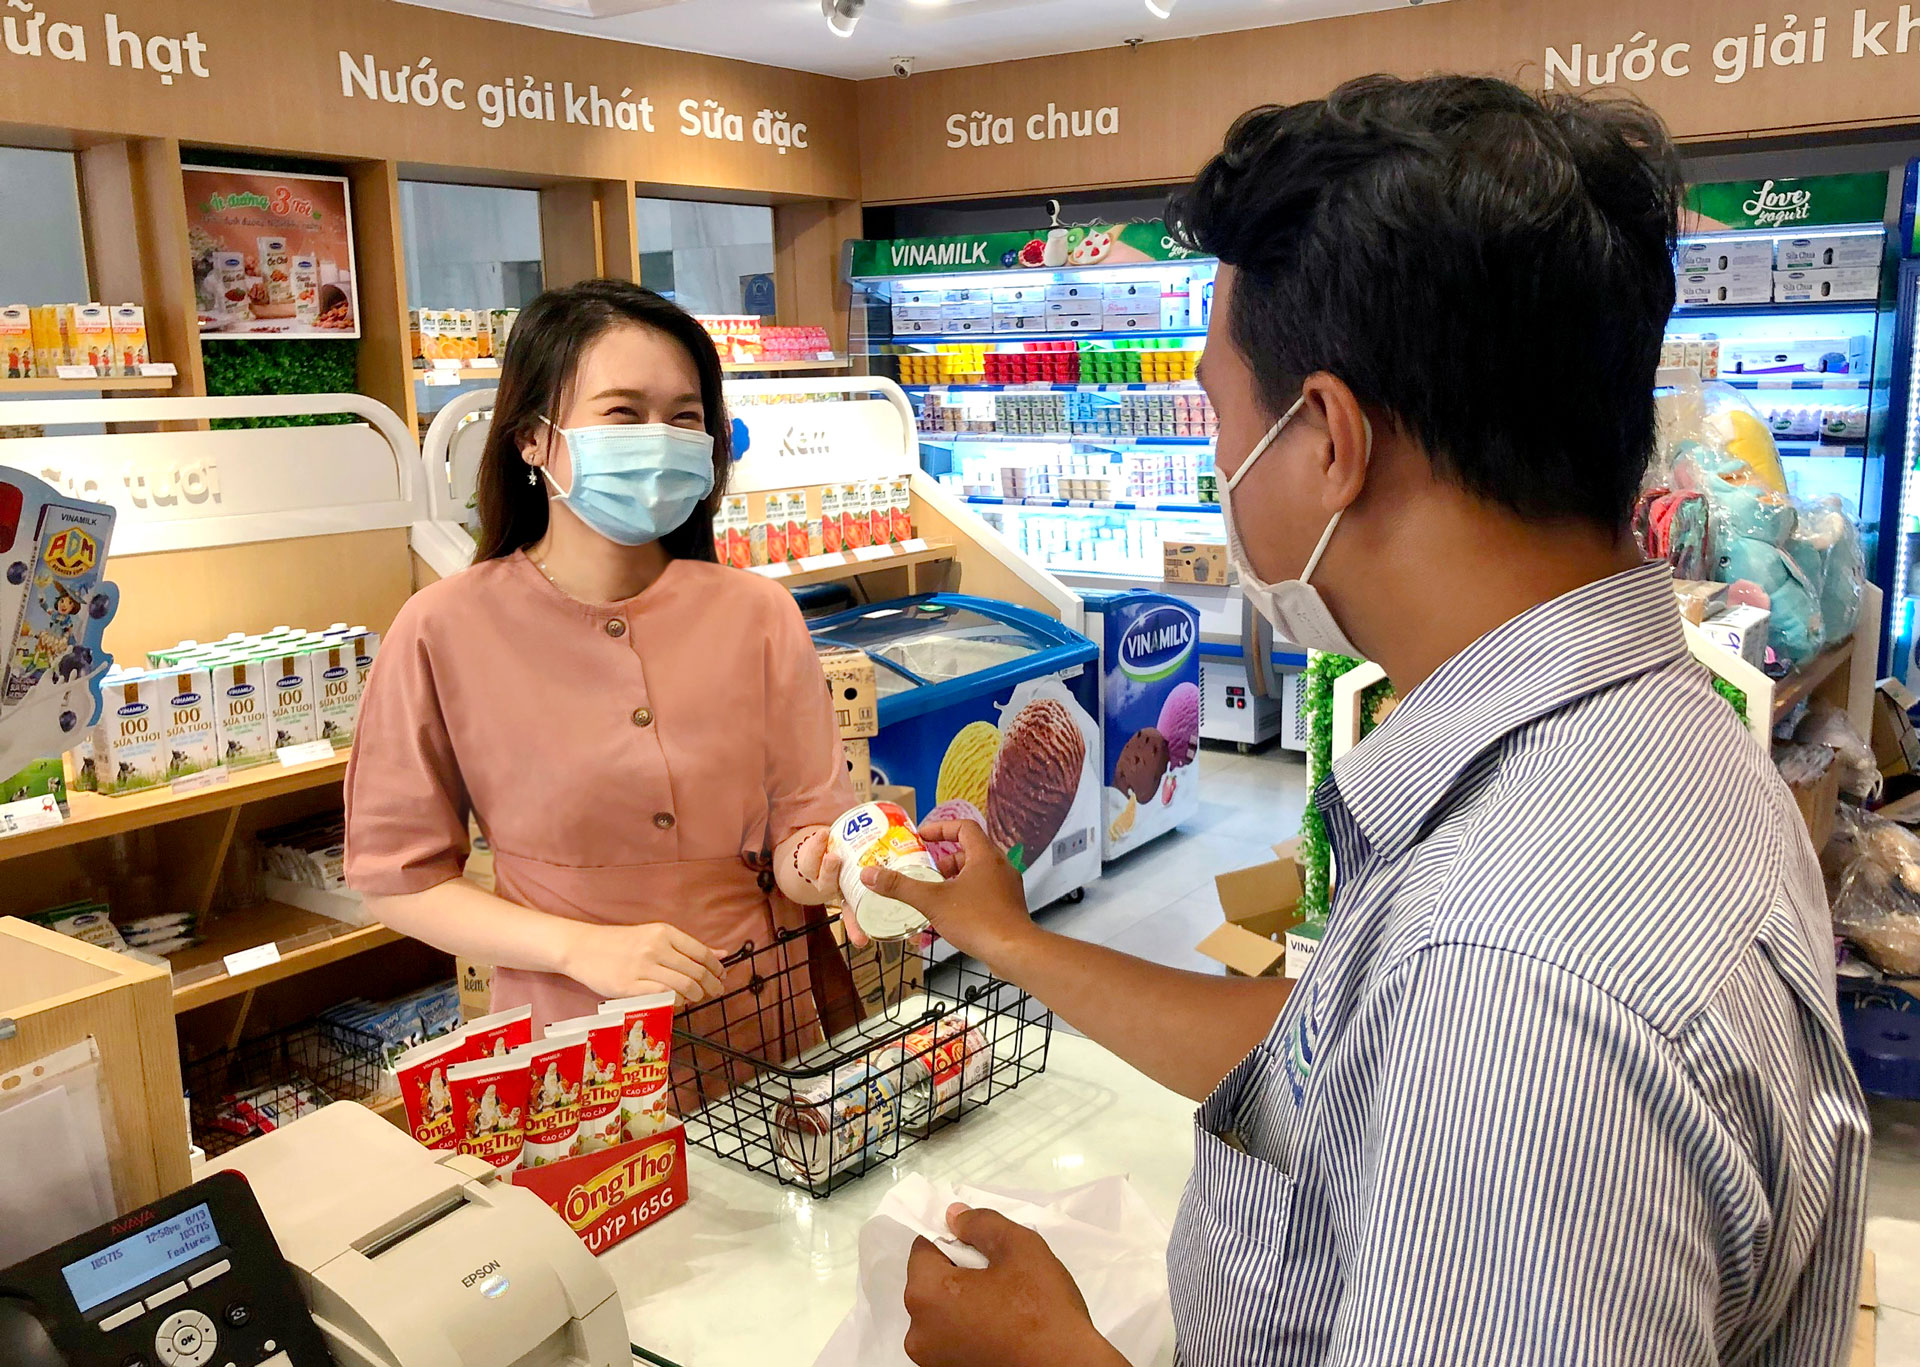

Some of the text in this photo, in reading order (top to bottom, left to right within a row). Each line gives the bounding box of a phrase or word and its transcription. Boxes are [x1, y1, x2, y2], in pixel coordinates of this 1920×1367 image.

[0, 0, 209, 85] ữa hạt
[1544, 4, 1920, 90] Nước giải kh
[338, 51, 655, 133] Nước giải khát
[679, 99, 808, 154] Sữa đặc
[946, 103, 1119, 148] Sữa chua
[271, 186, 292, 216] 3
[1742, 179, 1811, 216] Love
[1753, 202, 1809, 227] yogurt
[891, 241, 988, 267] VINAMILK
[61, 513, 97, 526] VINAMILK
[1127, 621, 1189, 659] VINAMILK
[278, 690, 302, 707] 100
[325, 681, 347, 698] 100
[173, 708, 200, 725] 100
[229, 699, 254, 716] 100
[120, 718, 148, 736] 100
[847, 813, 873, 836] 45
[1291, 940, 1315, 953] VINA
[464, 975, 484, 992] kem
[622, 1064, 667, 1083] ngThọ
[581, 1086, 619, 1106] gThọ
[416, 1117, 455, 1143] Ông
[185, 1209, 206, 1226] 8/13
[631, 1187, 673, 1226] 165G
[167, 1235, 211, 1259] Features
[462, 1260, 501, 1289] EPSON
[181, 1334, 195, 1346] OK
